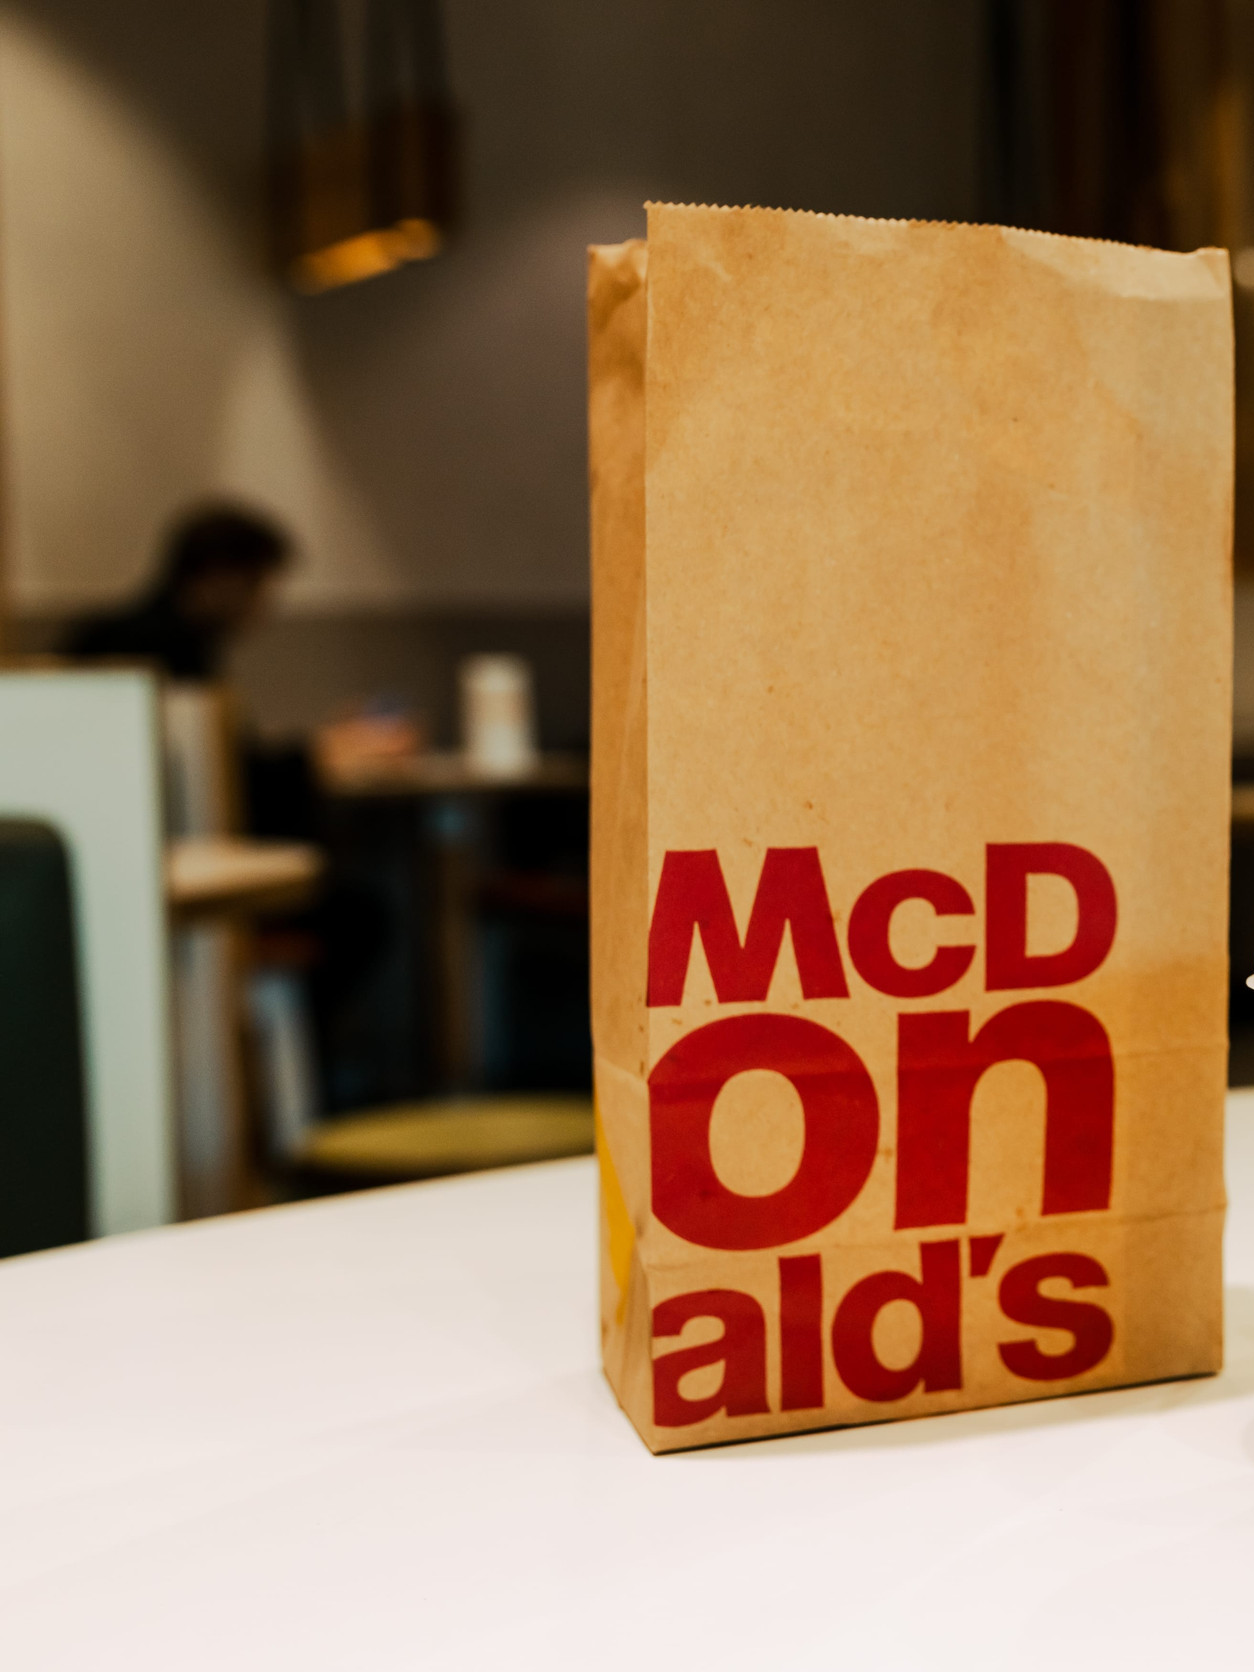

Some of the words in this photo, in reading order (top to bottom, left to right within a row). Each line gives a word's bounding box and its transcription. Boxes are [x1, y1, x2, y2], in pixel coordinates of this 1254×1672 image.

[646, 842, 1117, 1008] McD
[647, 1000, 1115, 1251] on
[651, 1233, 1115, 1428] ald's
